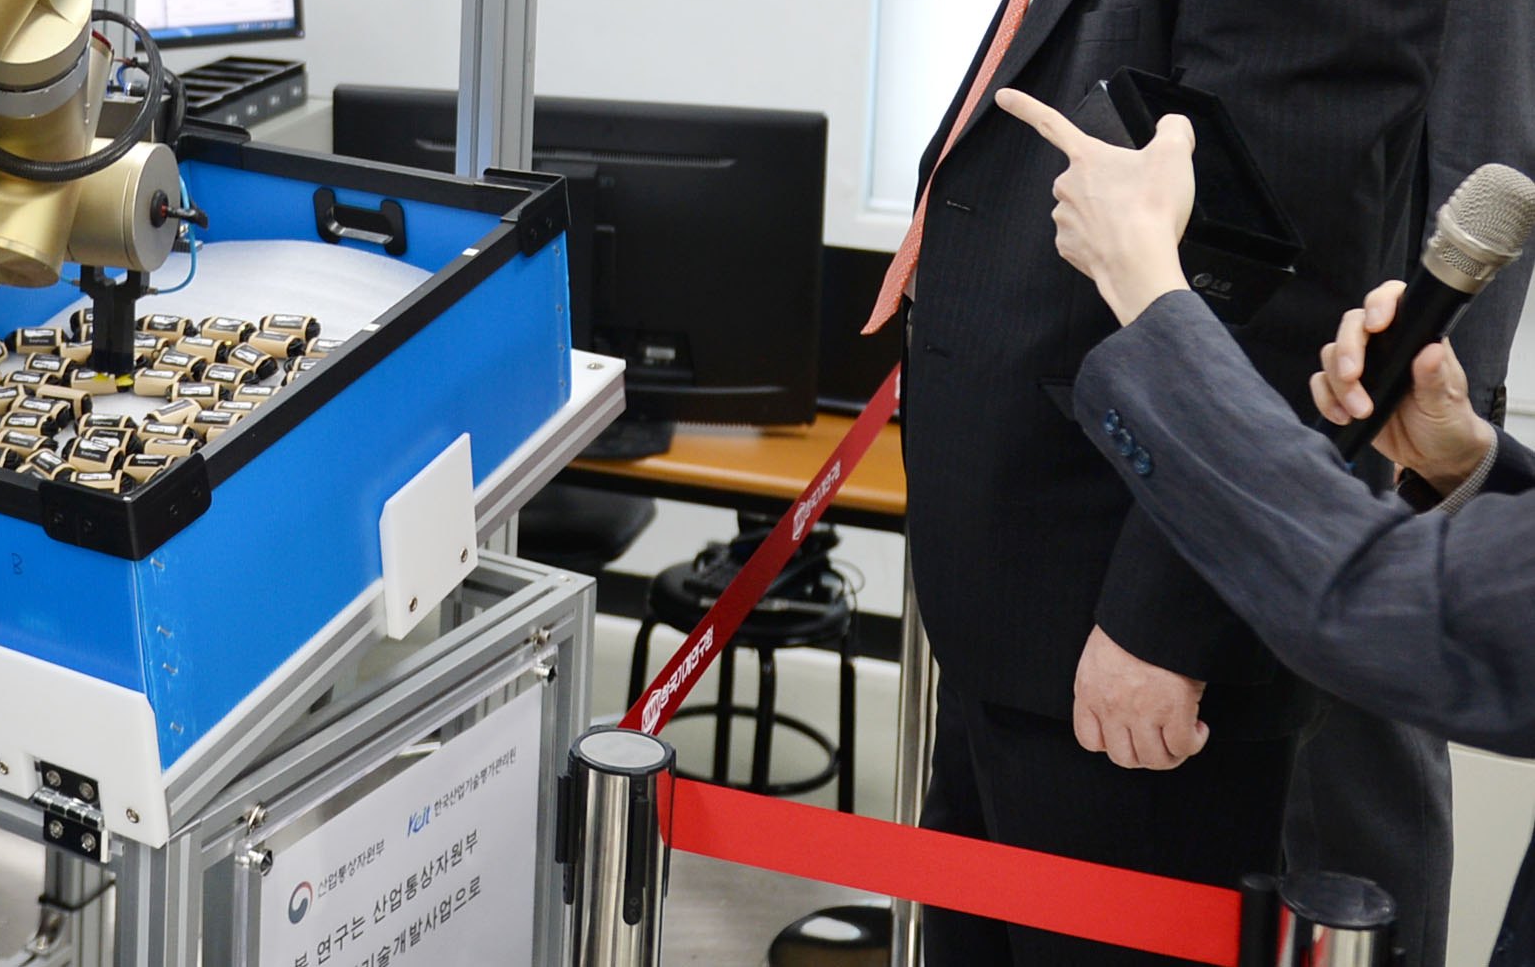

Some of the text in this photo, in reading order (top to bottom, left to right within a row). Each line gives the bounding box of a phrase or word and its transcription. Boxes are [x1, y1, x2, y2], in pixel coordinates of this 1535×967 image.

[661, 625, 714, 710] 한국기계연구원
[433, 745, 518, 818] 한국산업기술평가관리원
[316, 916, 367, 966] 연구는
[373, 829, 479, 924] 산업통상자원부
[317, 839, 386, 900] 산업통상자원부
[355, 875, 482, 967] 기술개발사업으로
